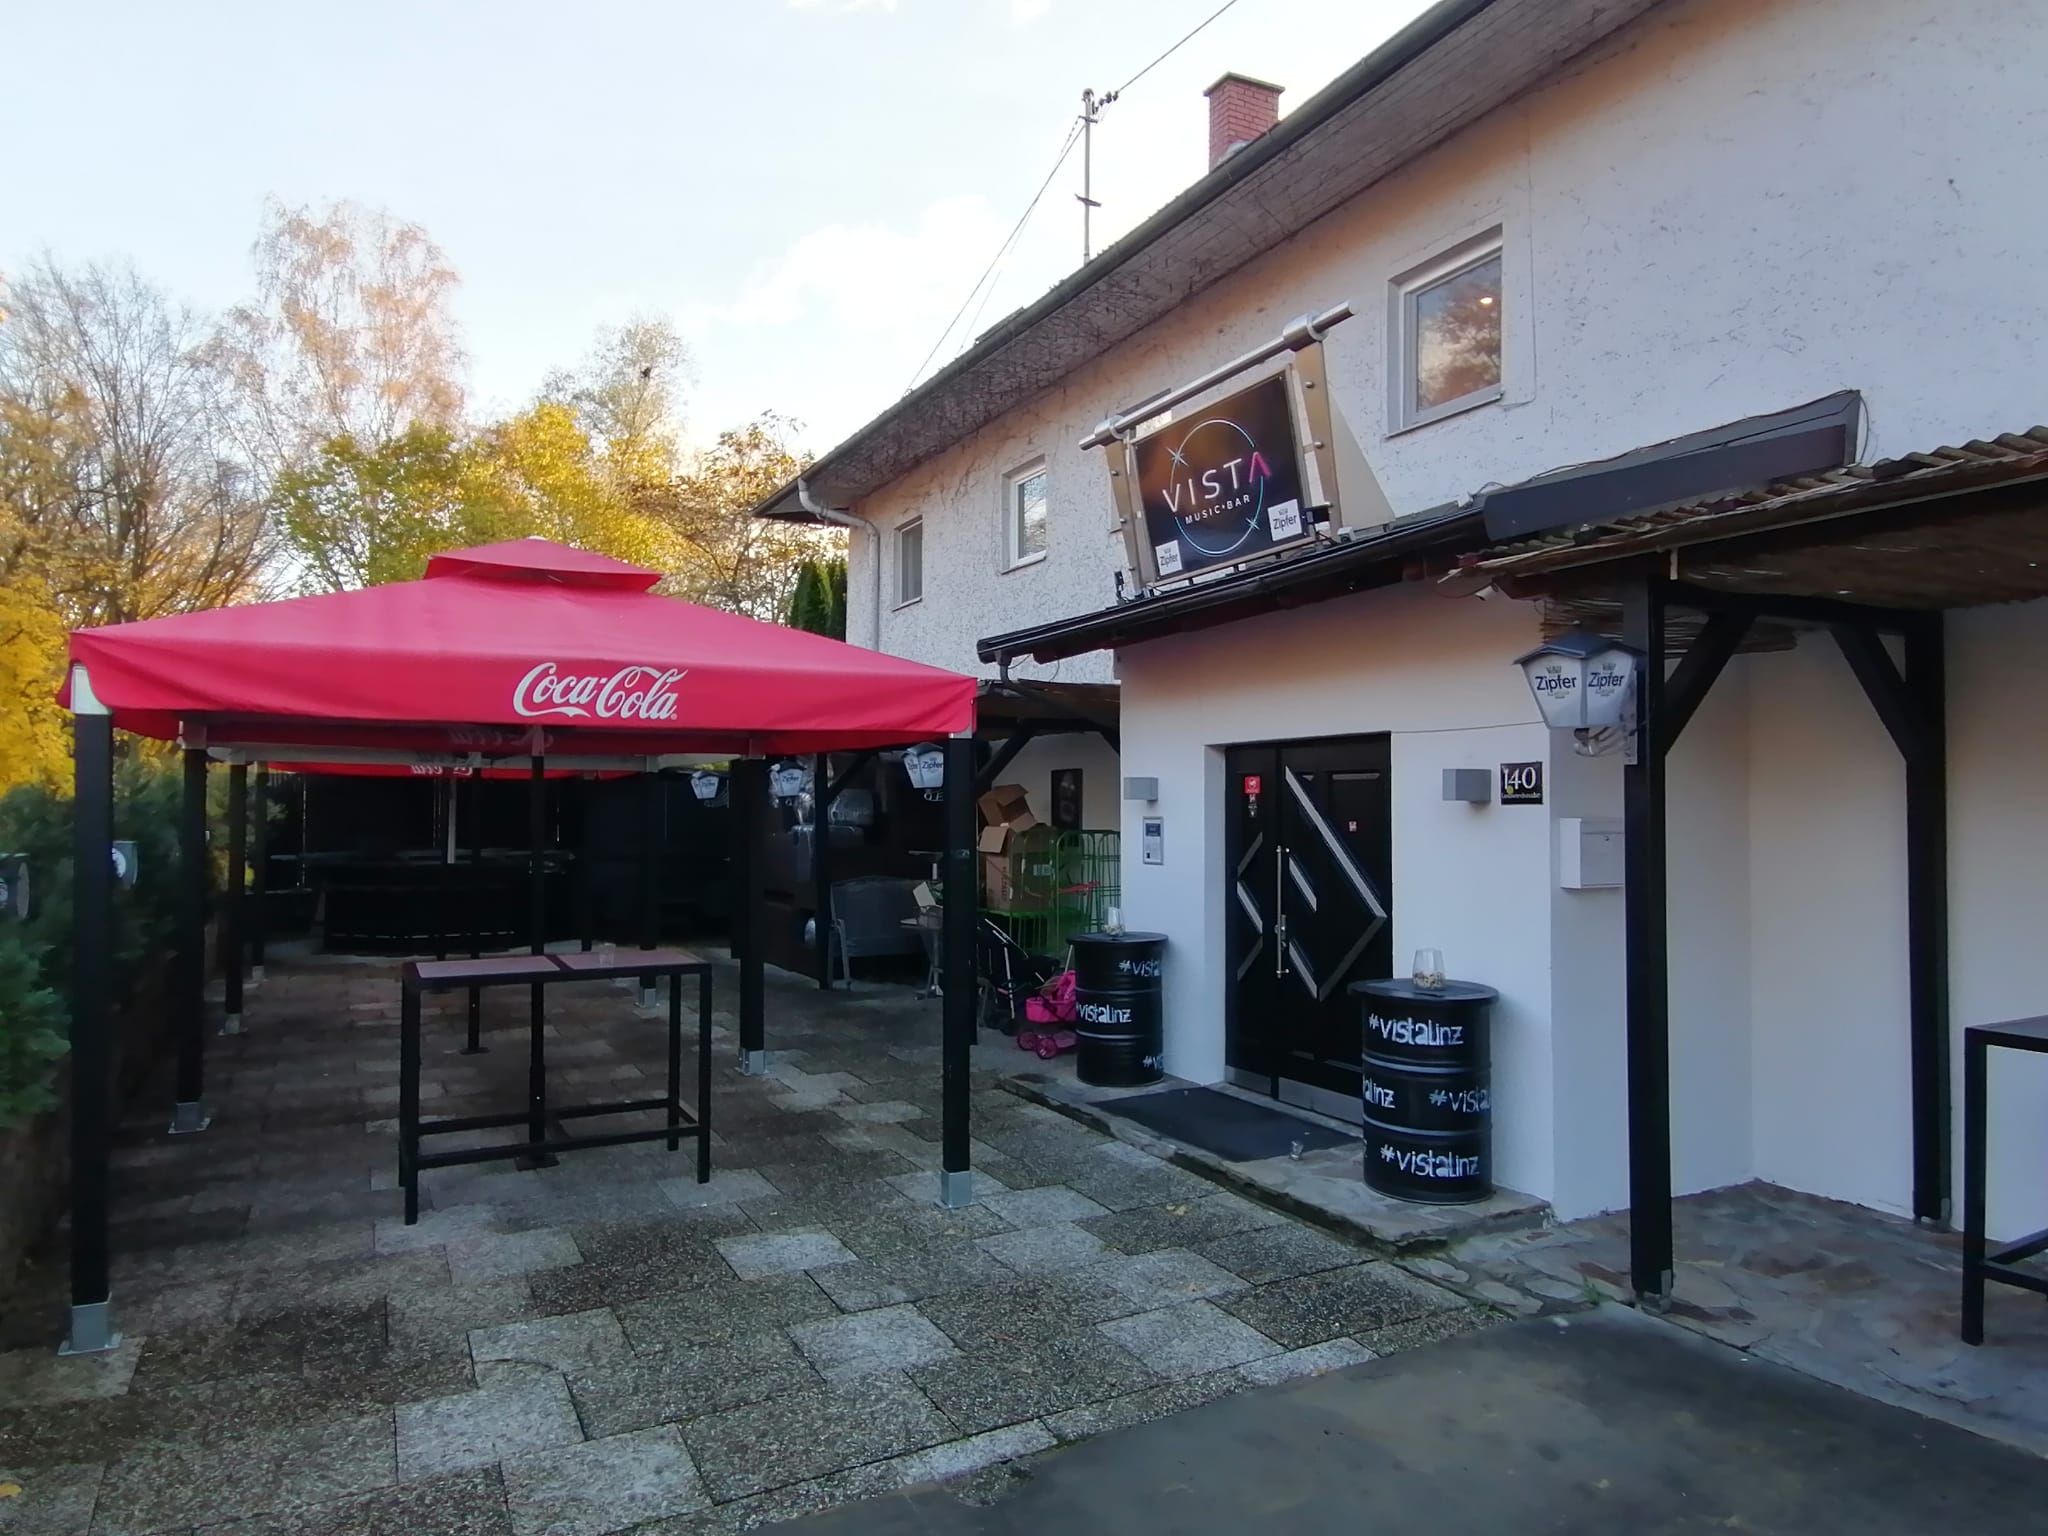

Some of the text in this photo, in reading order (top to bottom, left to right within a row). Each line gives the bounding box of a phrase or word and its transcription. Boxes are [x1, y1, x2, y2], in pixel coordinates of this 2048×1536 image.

[1162, 450, 1272, 514] VISTA
[1272, 514, 1298, 532] Zipfer
[1159, 553, 1179, 568] Zipfer
[513, 662, 688, 720] Coca-Cola
[1535, 675, 1577, 693] Zipfer
[1588, 672, 1625, 691] Zipfer
[1502, 766, 1537, 790] 140
